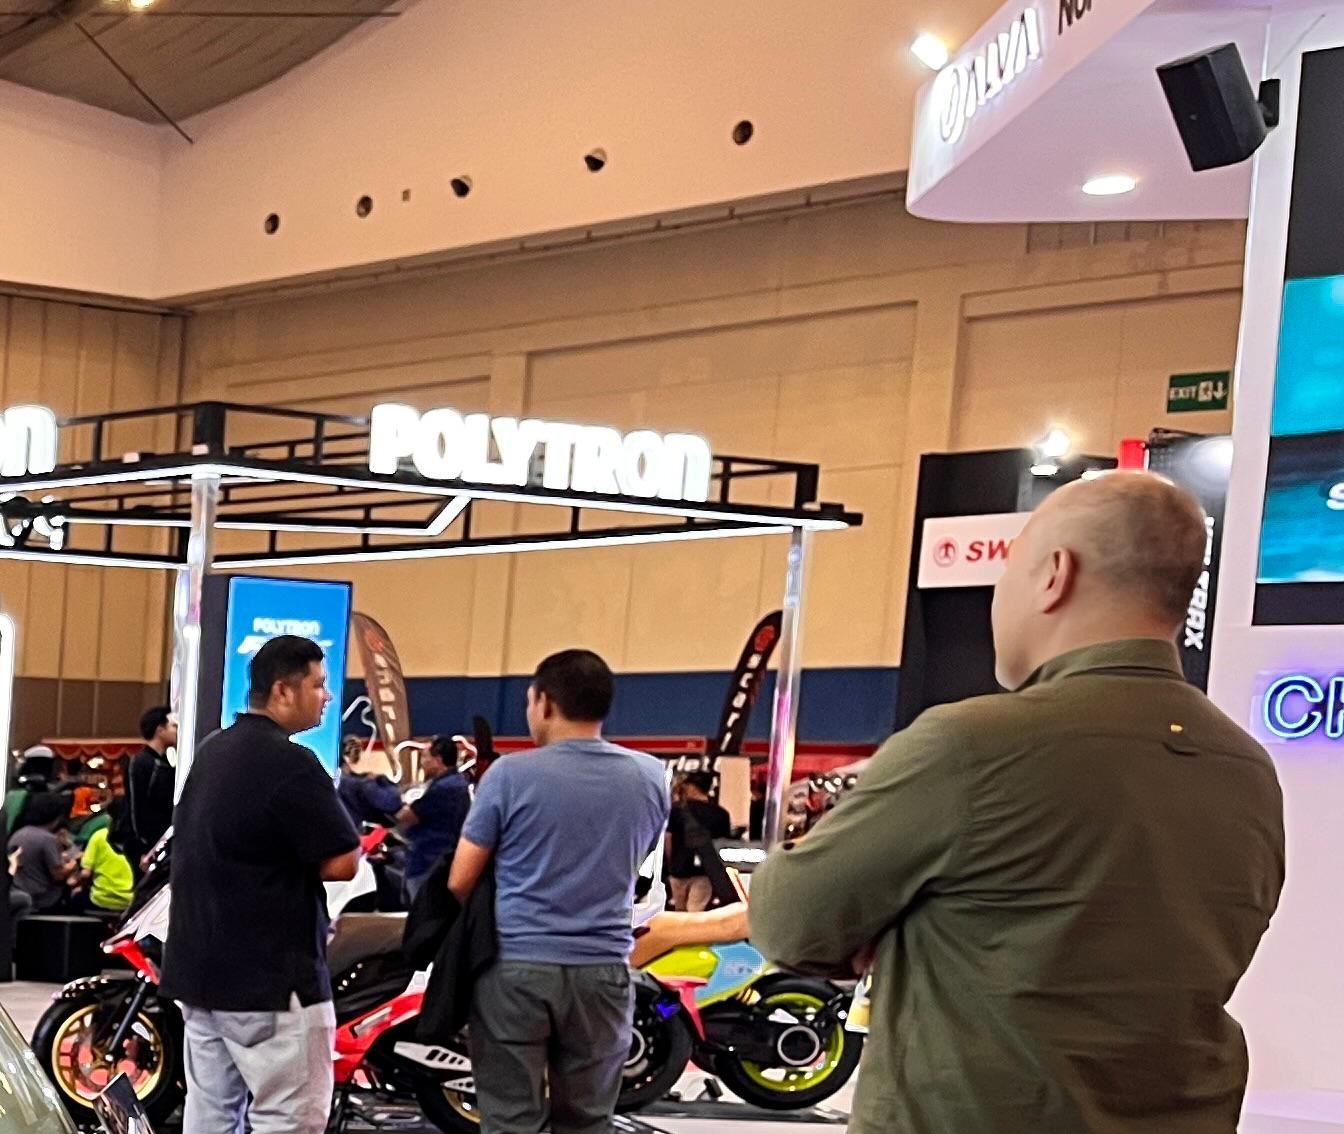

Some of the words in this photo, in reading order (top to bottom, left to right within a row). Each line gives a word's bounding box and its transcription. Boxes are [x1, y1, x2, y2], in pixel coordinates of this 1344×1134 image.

[1169, 385, 1197, 401] EXIT
[369, 402, 710, 503] POLYTRON
[966, 540, 1010, 562] SW
